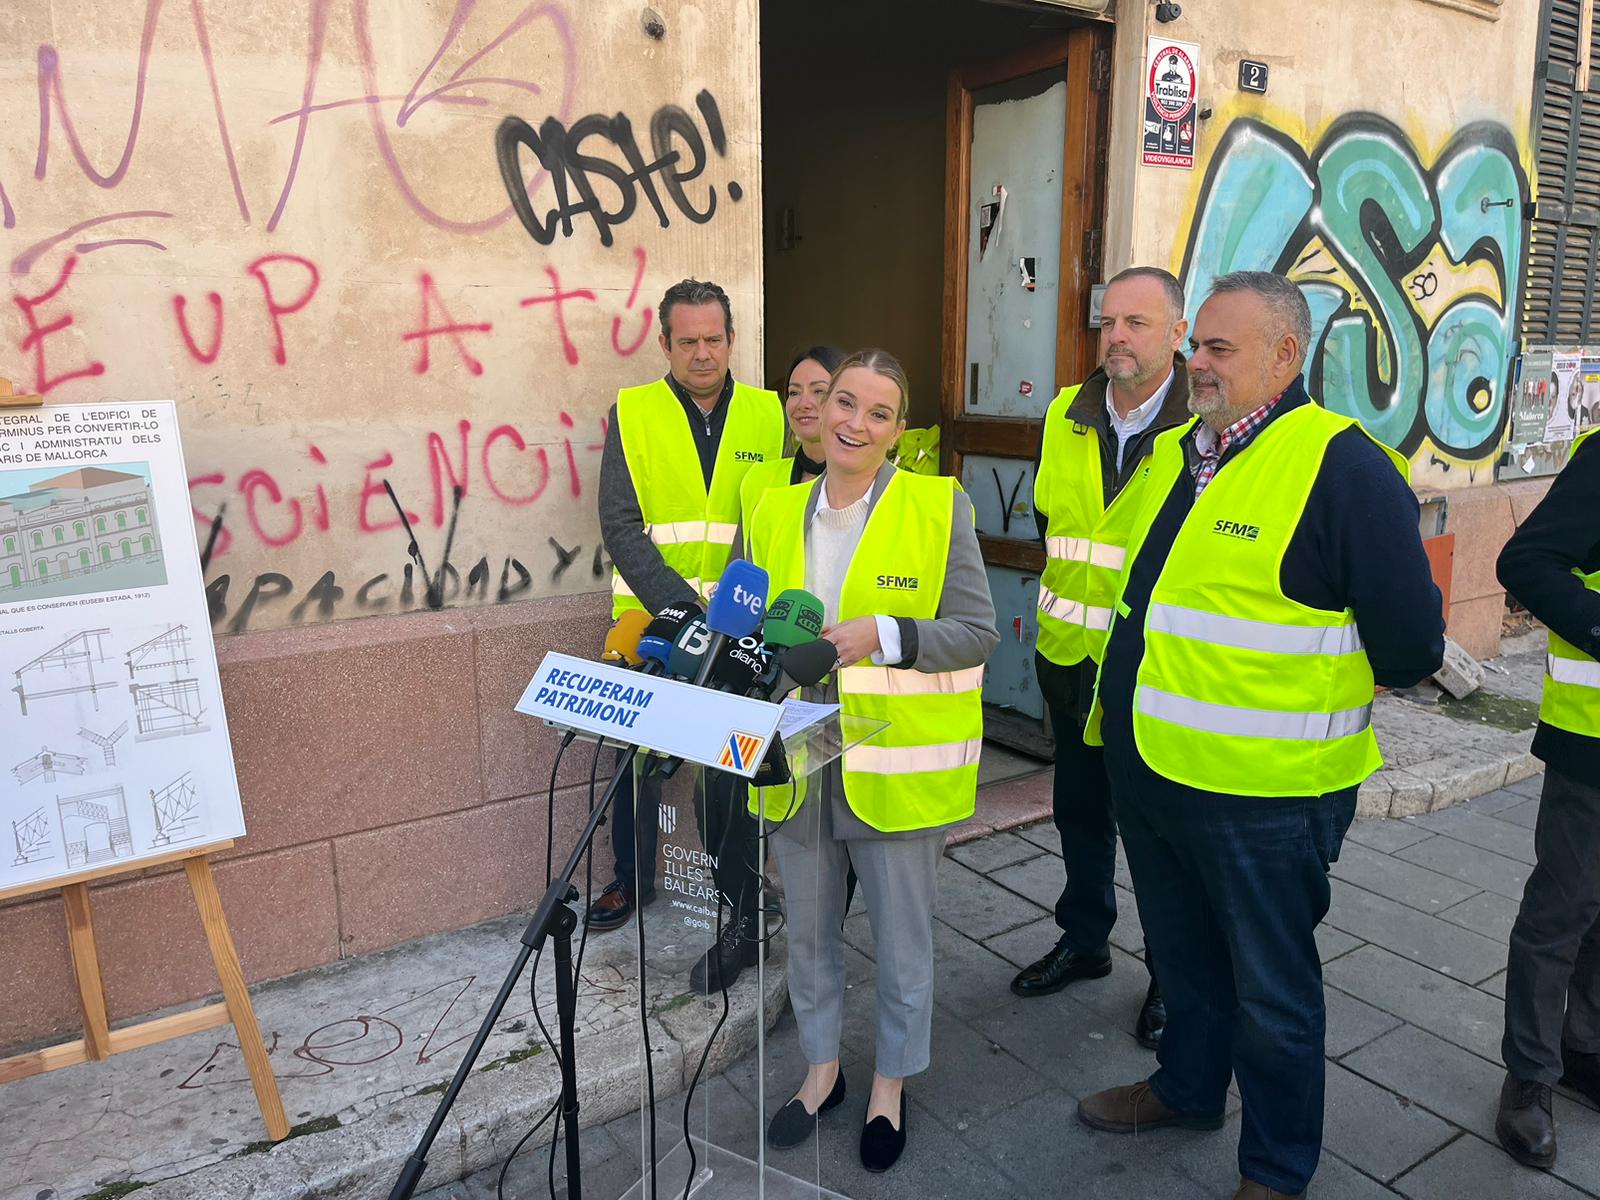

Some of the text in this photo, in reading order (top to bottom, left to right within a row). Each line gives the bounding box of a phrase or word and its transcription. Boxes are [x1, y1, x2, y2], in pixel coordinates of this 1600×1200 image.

[1249, 66, 1260, 88] 2
[1155, 83, 1188, 98] Trablisa
[1144, 154, 1192, 166] VIDEOVIGILANCIA
[54, 412, 71, 422] DE
[82, 410, 130, 421] L'EDIFICI
[141, 409, 157, 418] DE
[47, 425, 71, 435] PER
[74, 420, 159, 432] CONVERTIR-LO
[34, 436, 122, 449] ADMINISTRATIU
[132, 434, 161, 444] DELS
[25, 453, 42, 463] DE
[44, 449, 108, 461] MALLORCA
[734, 450, 757, 461] SFM
[1213, 519, 1249, 536] SFM
[876, 575, 908, 588] SFM
[11, 606, 25, 614] QUE
[37, 600, 78, 611] CONSERVEN
[733, 584, 762, 615] tve
[729, 648, 763, 674] diario
[545, 667, 654, 709] RECUPERAM
[534, 687, 640, 729] PATRIMONI
[662, 843, 719, 870] GOVERN
[663, 859, 704, 882] ILLES
[664, 876, 720, 904] BALEARS
[683, 916, 711, 929] @goib
